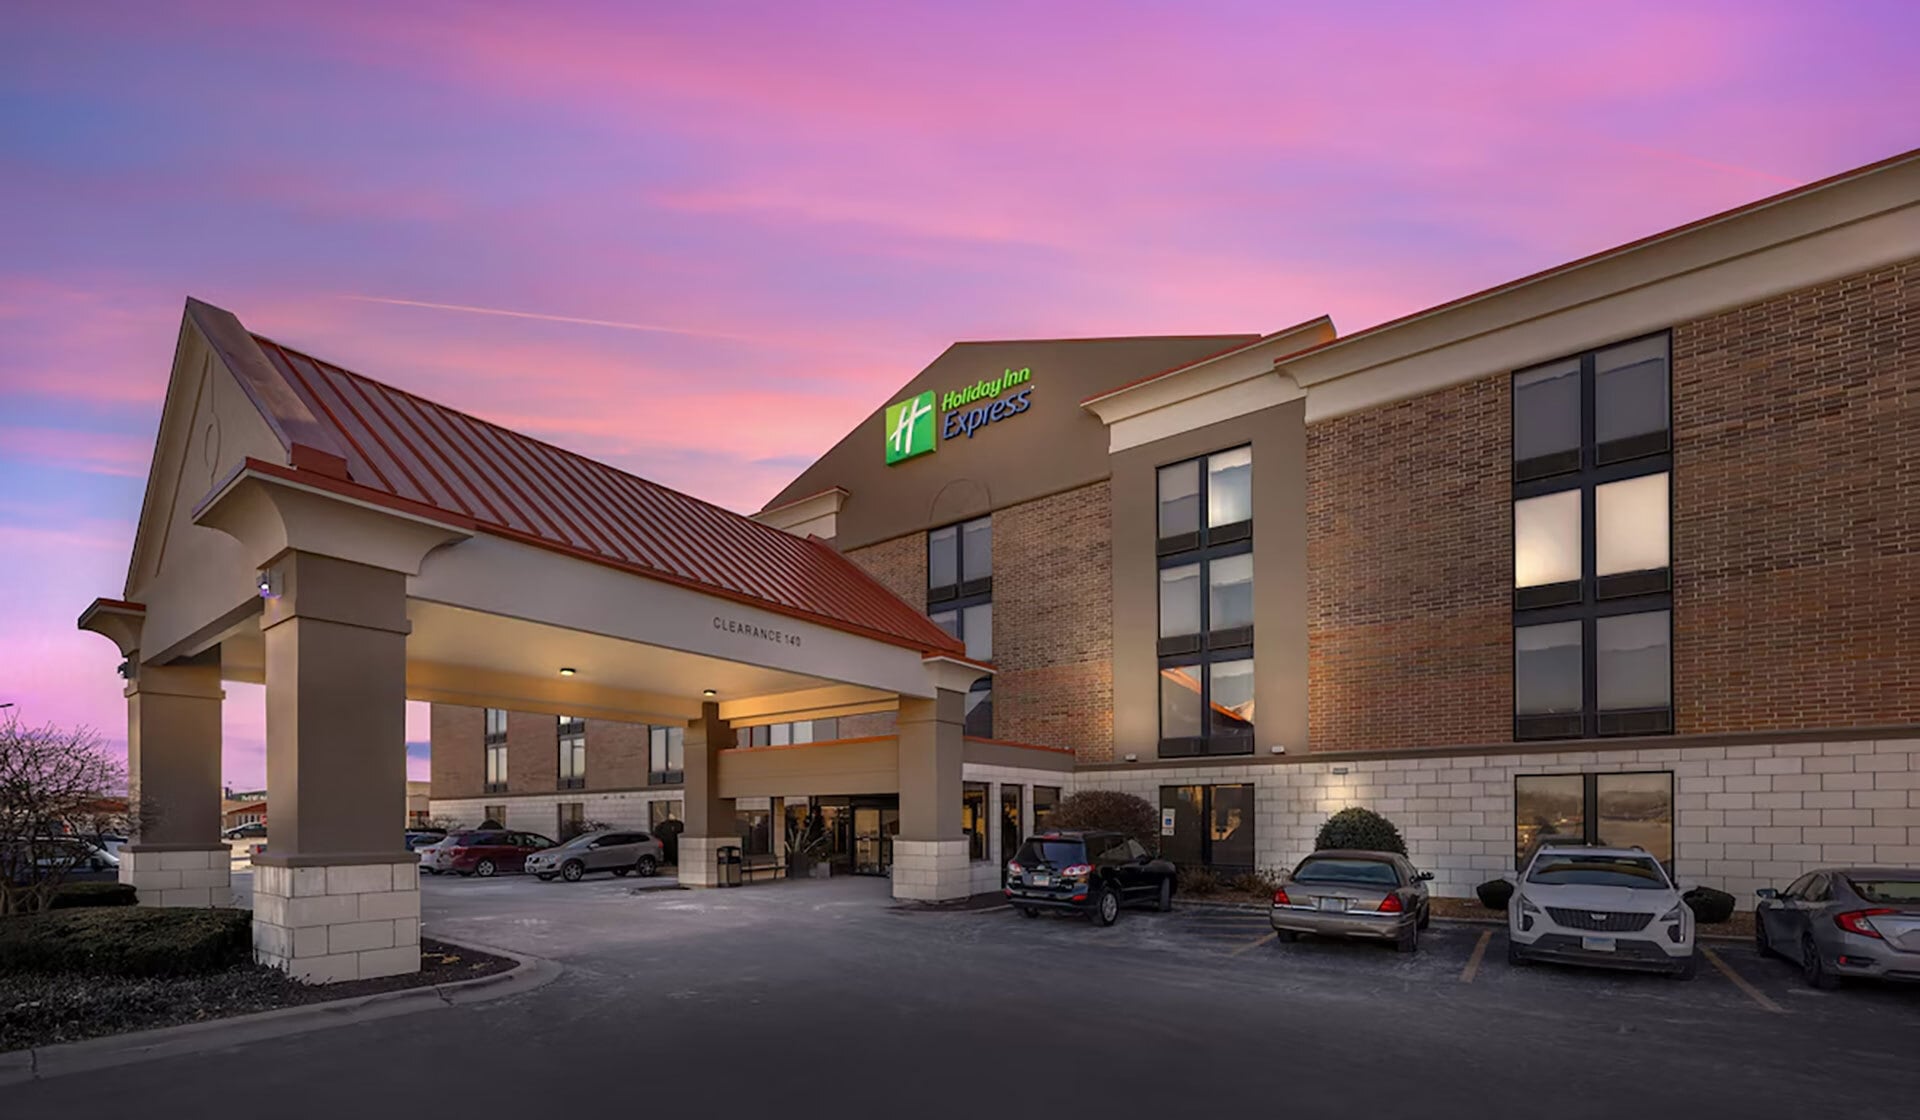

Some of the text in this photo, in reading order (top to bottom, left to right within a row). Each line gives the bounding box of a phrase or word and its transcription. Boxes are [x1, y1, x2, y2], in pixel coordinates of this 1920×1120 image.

[941, 367, 1031, 412] Holiday Inn
[943, 389, 1032, 440] Express
[713, 616, 782, 643] CLEARANCE
